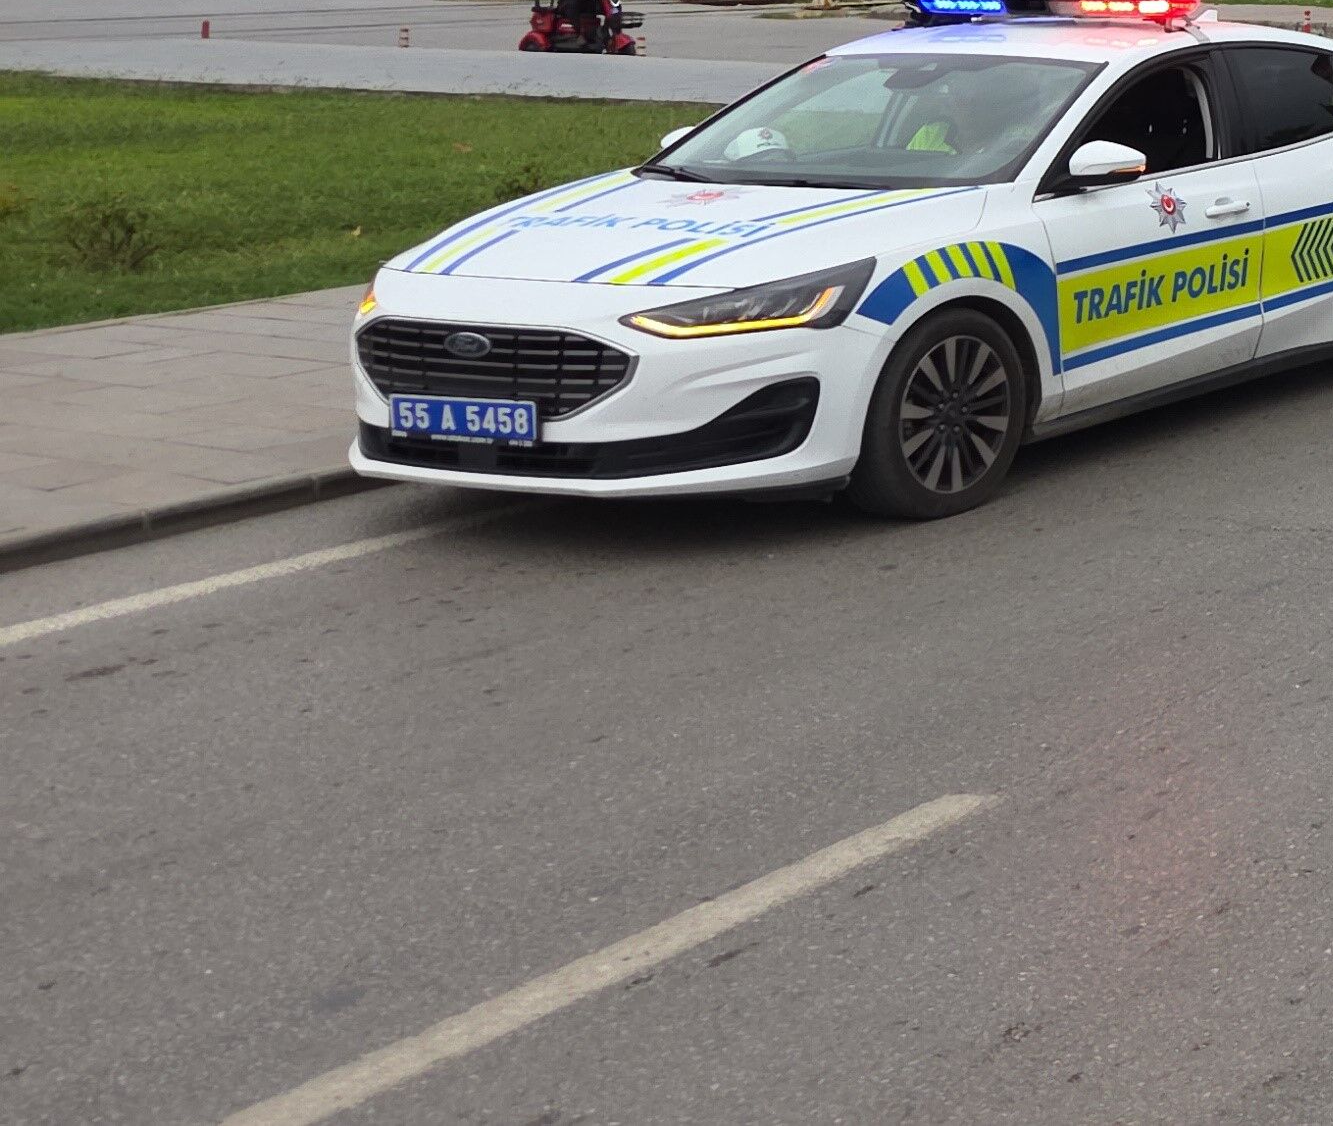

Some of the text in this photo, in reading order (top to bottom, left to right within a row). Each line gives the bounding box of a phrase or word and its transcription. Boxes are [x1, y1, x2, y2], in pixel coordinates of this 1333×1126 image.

[1074, 247, 1250, 324] TRAFİK POLİSİ
[399, 402, 529, 434] 55 A 5458
